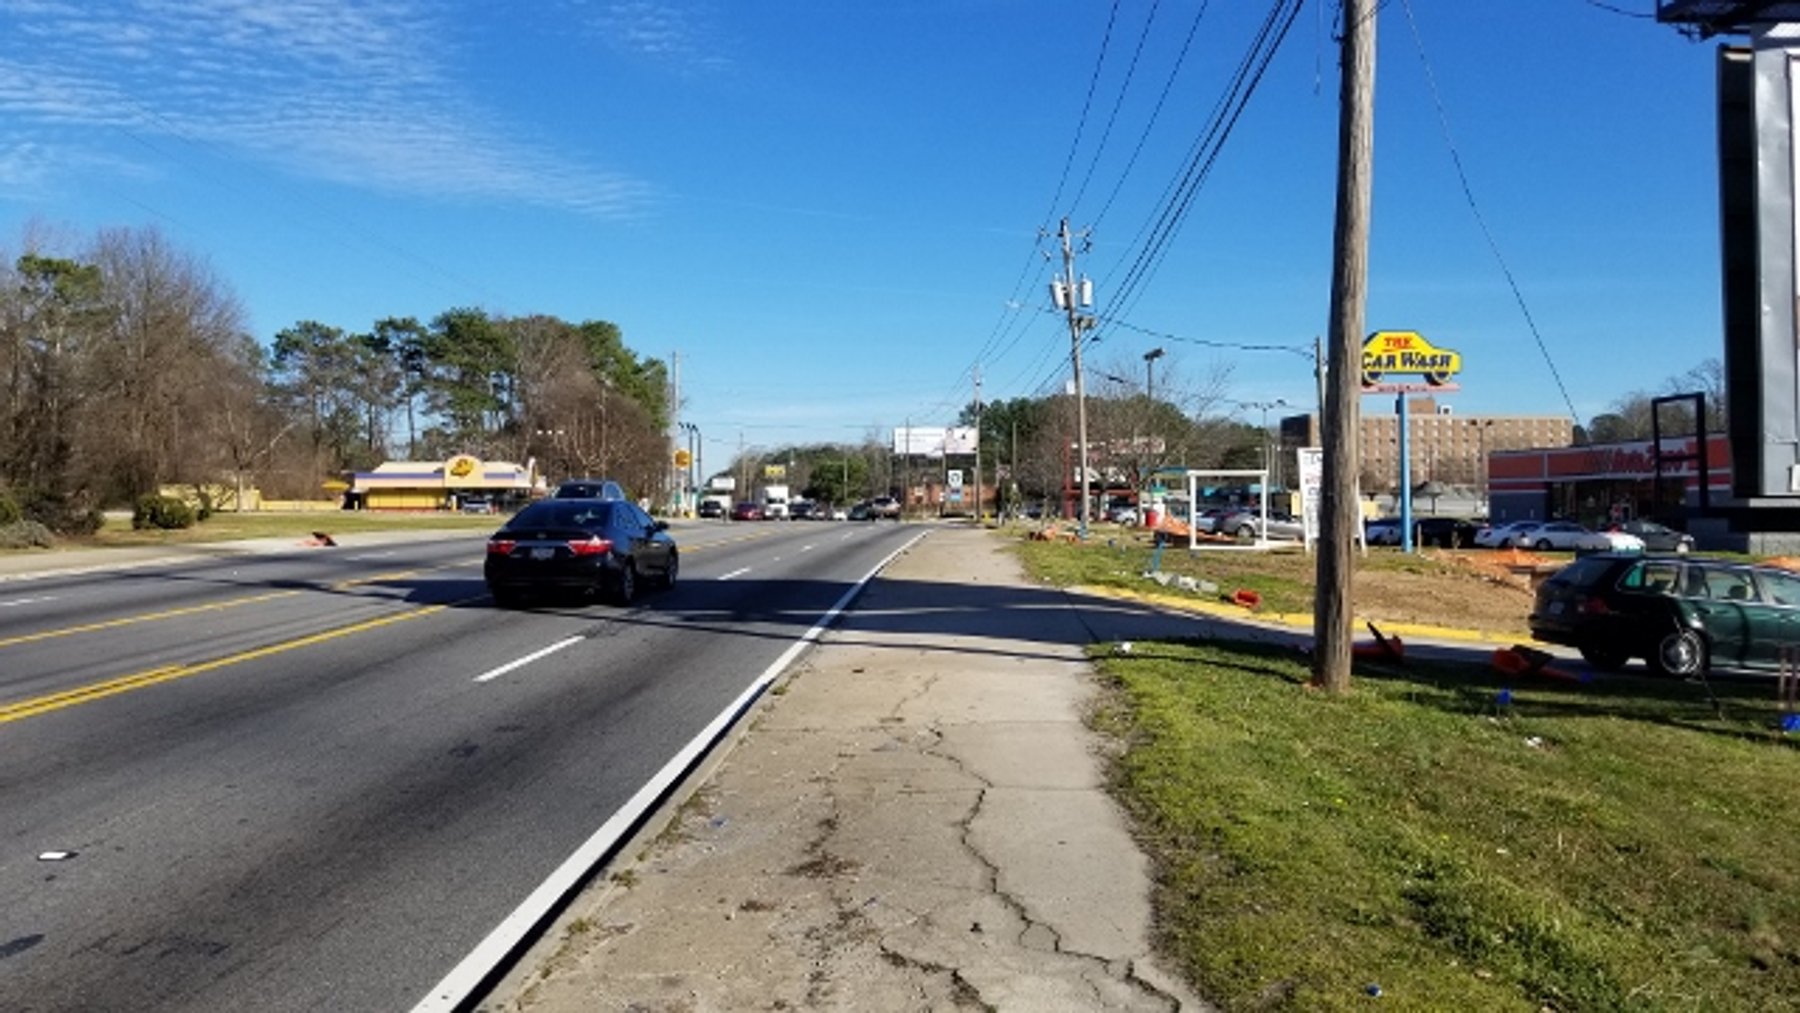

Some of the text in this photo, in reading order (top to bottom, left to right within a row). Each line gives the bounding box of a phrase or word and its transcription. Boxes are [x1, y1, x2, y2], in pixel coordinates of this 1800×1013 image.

[1384, 337, 1412, 349] THE
[1361, 351, 1452, 369] CAR WASH
